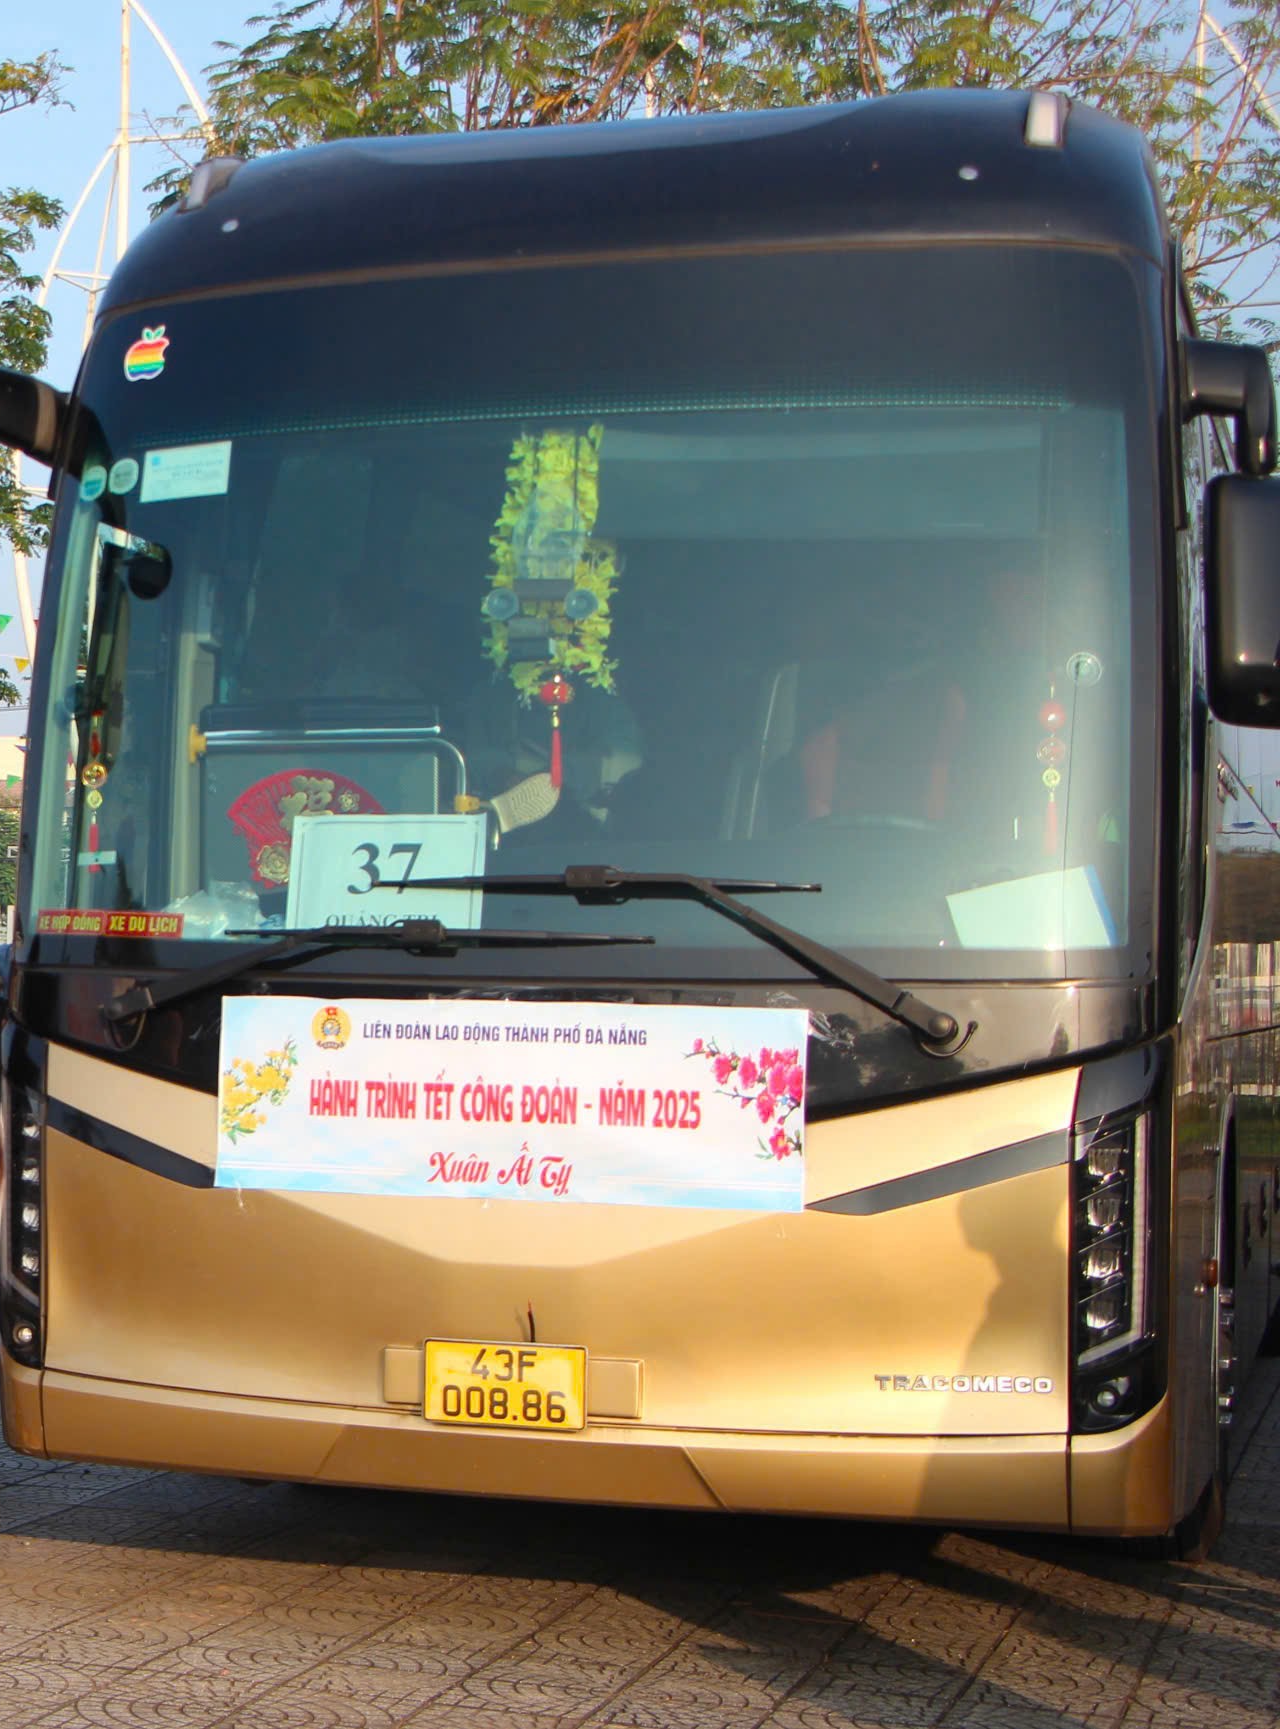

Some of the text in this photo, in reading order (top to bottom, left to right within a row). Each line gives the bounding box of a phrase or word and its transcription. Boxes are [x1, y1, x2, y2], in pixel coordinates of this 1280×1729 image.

[346, 842, 422, 894] 37
[39, 914, 50, 929] XE
[109, 915, 178, 935] XE DU LỊCH
[362, 1019, 647, 1046] LIÊN ĐOÀN LAO ĐỘNG THÀNH PHỐ ĐÀ NẴNG
[310, 1070, 359, 1117] HÀNH
[365, 1072, 417, 1119] TRÌNH
[423, 1068, 455, 1121] TẾT
[460, 1075, 514, 1123] CÔNG
[521, 1077, 577, 1125] ĐOÀN
[599, 1079, 646, 1127] NĂM
[652, 1089, 701, 1129] 2025
[427, 1141, 573, 1196] Xuân Ất Tỵ
[471, 1348, 538, 1382] 43F
[874, 1374, 1054, 1394] TRACOMECO
[442, 1384, 567, 1423] 008.86
